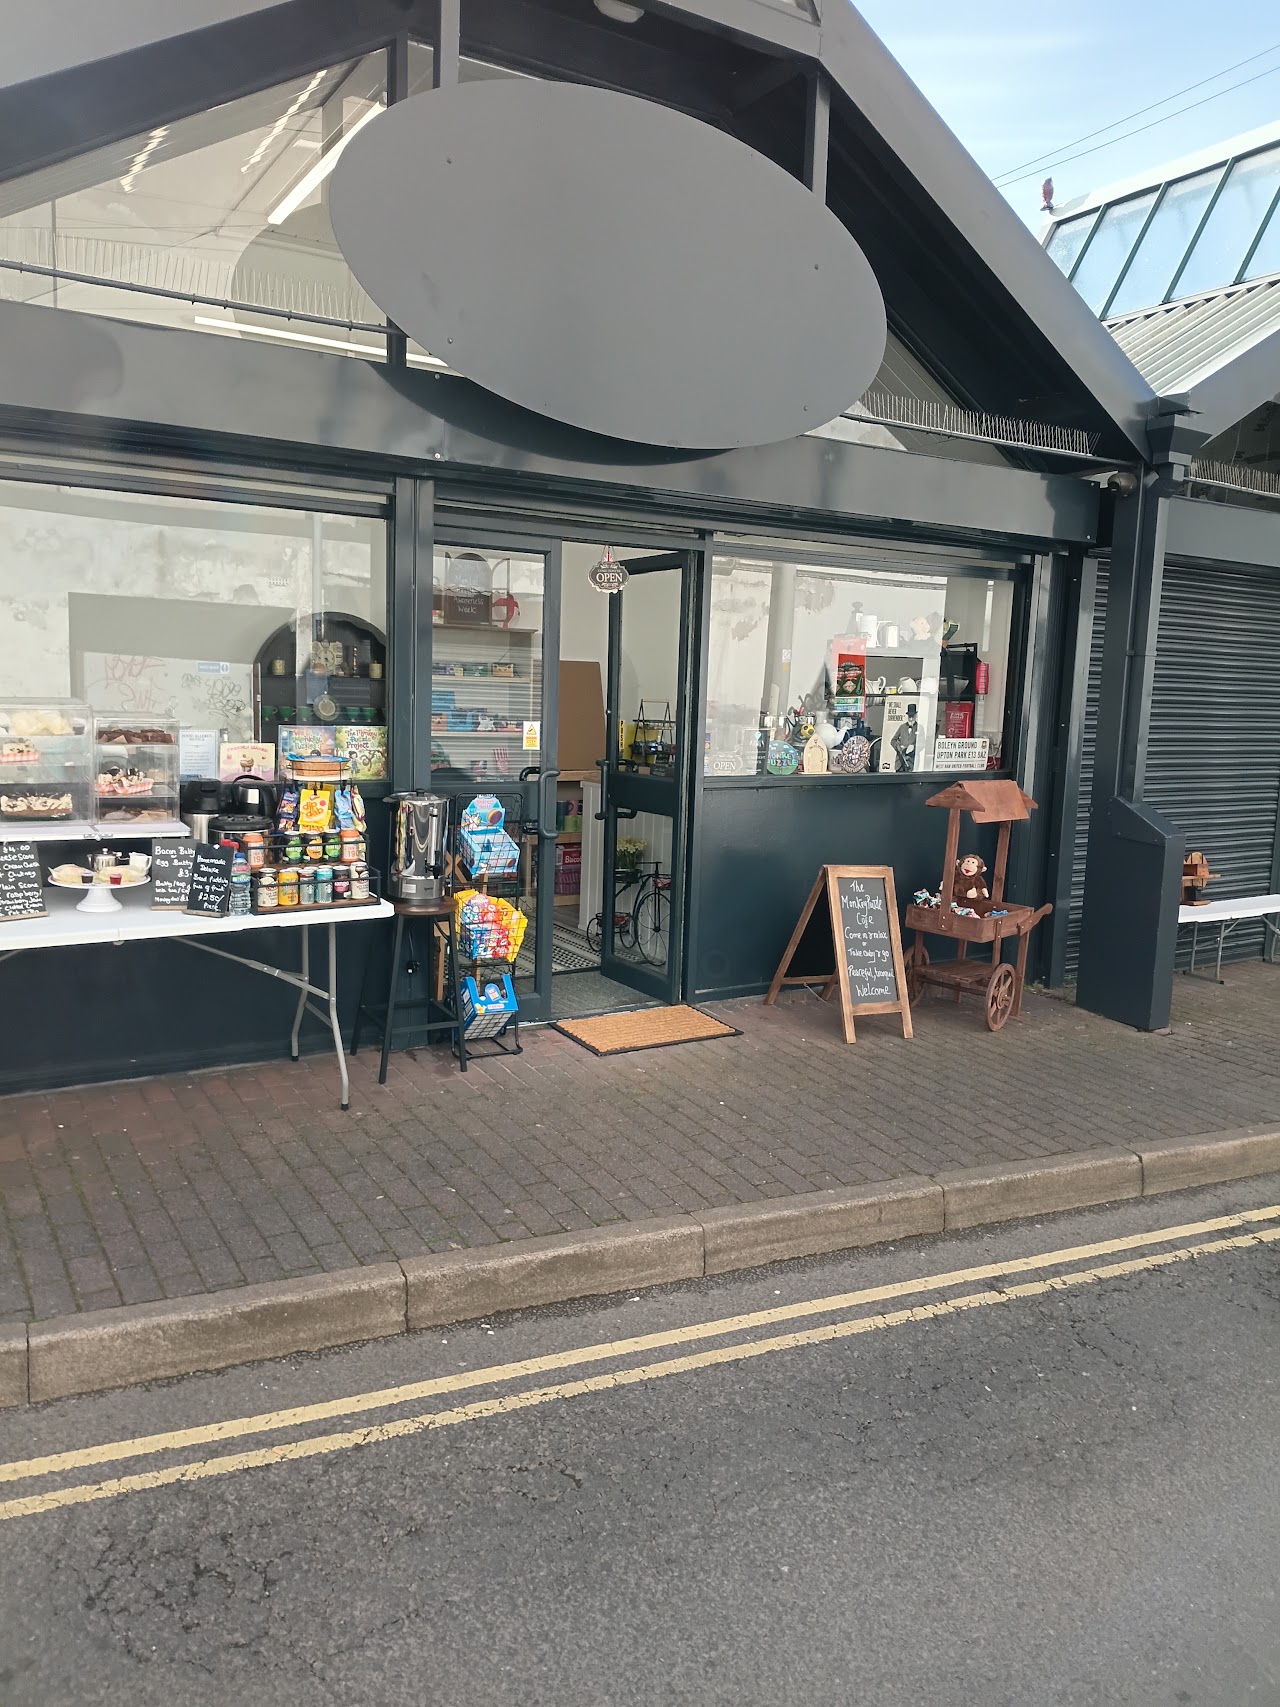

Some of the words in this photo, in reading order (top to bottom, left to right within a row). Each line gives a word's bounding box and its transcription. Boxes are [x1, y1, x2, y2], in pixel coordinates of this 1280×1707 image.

[596, 572, 622, 582] OPEN
[458, 606, 476, 614] Week
[713, 761, 736, 770] OPEN
[303, 802, 317, 812] dip
[306, 807, 324, 816] dab
[3, 845, 30, 854] £4.00
[155, 846, 177, 855] Bacon
[156, 858, 169, 867] Egg
[197, 854, 226, 865] Homemade
[177, 868, 192, 878] £3.
[850, 880, 865, 893] The
[845, 926, 862, 939] Come
[873, 930, 888, 940] relax
[847, 948, 863, 957] Take
[881, 950, 889, 962] go
[855, 982, 891, 997] Welcome
